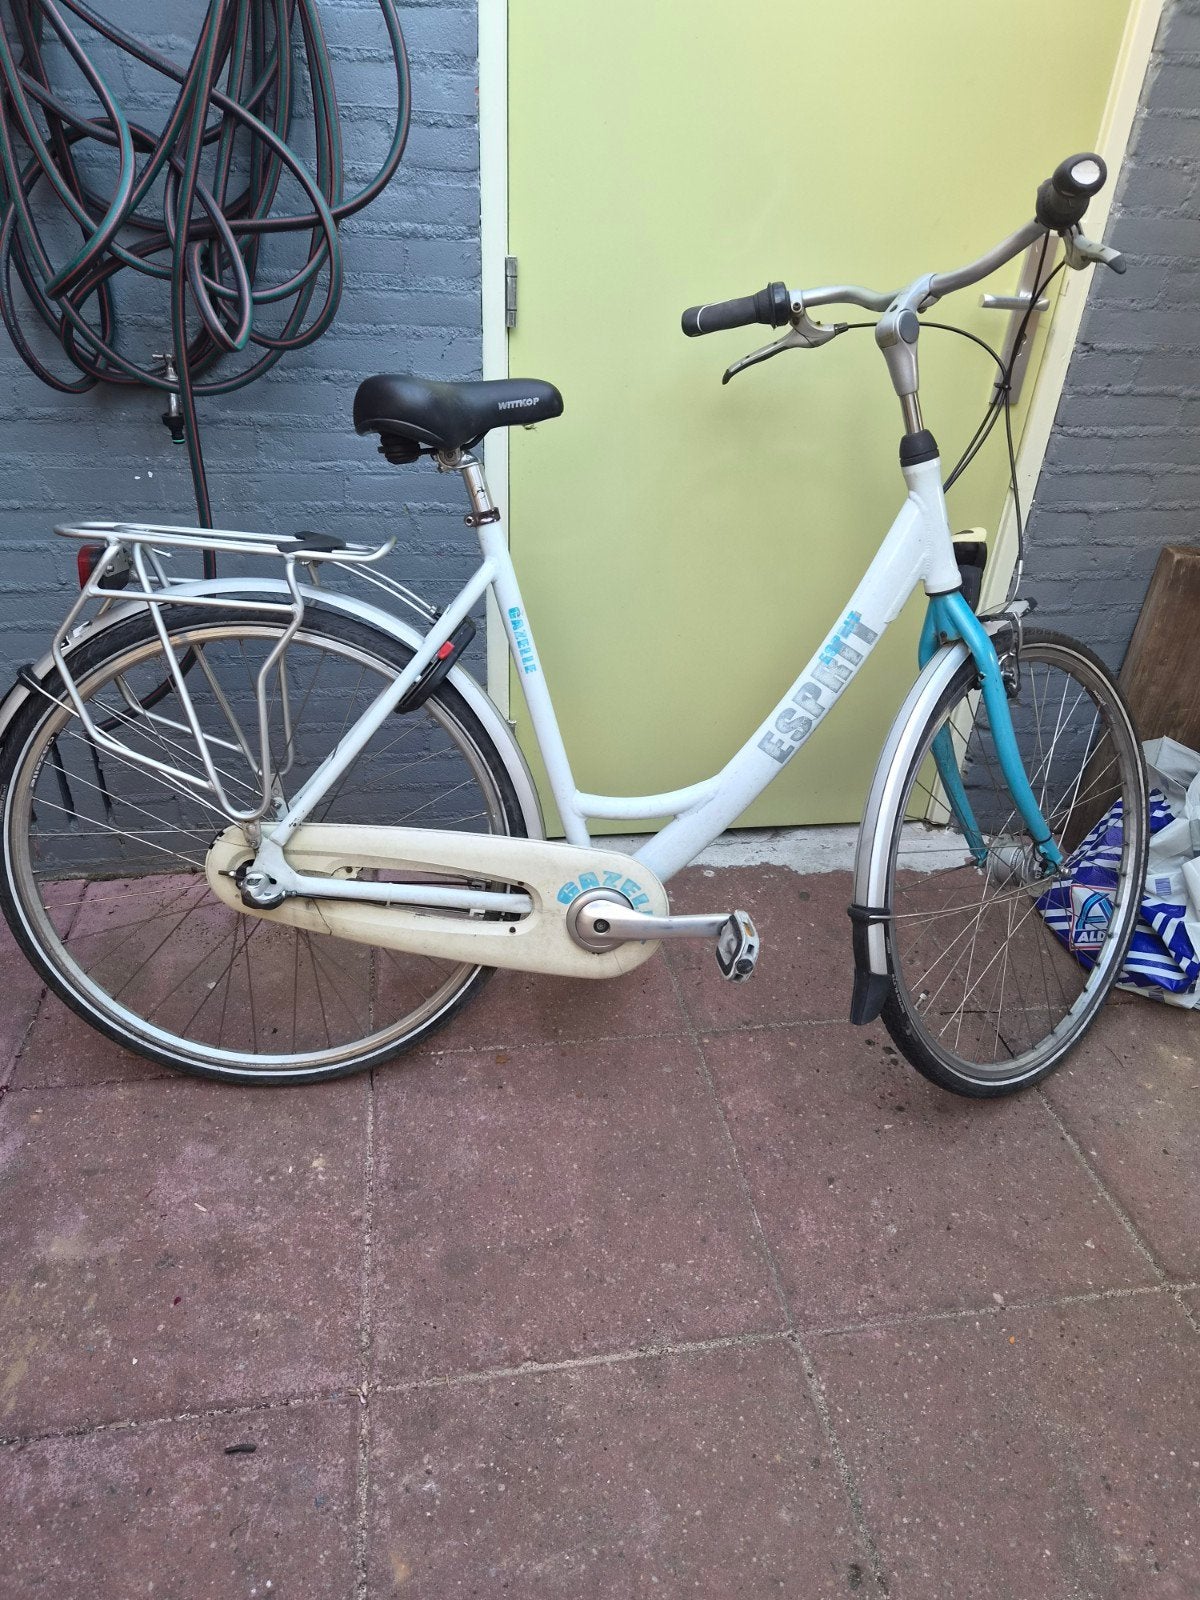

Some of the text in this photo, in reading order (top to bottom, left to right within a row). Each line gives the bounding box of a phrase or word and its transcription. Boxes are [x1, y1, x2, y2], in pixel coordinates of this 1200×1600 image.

[498, 397, 539, 410] WITTKOP
[508, 607, 537, 674] GAZELLE
[757, 611, 879, 764] ESPRIT
[557, 870, 653, 916] GAZEL
[1077, 930, 1107, 943] ALD
